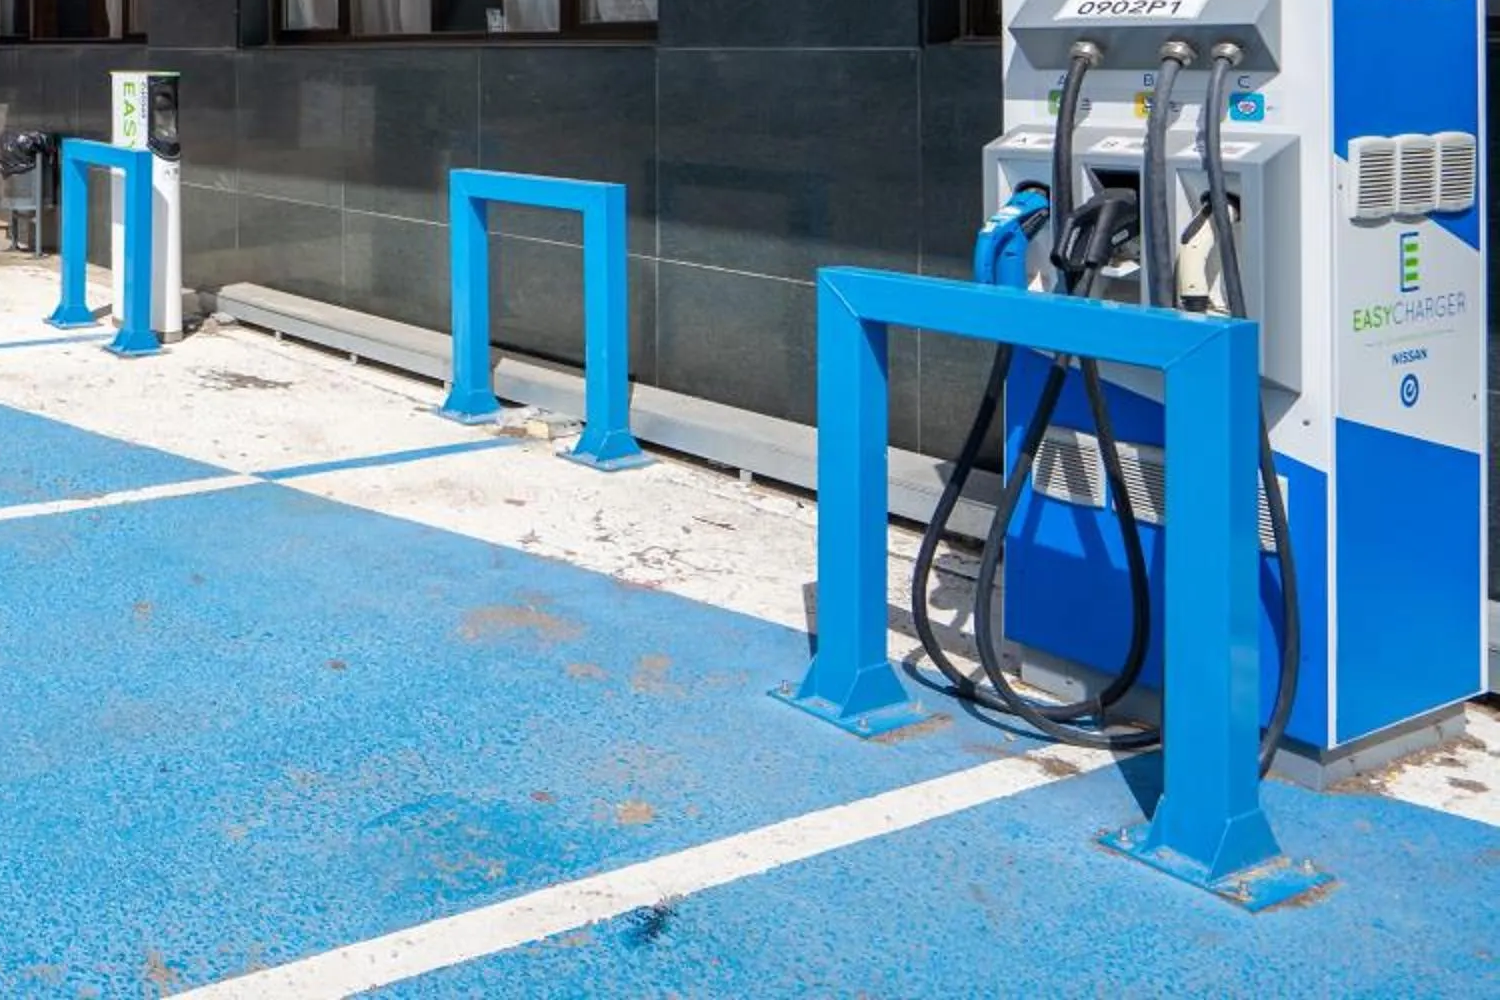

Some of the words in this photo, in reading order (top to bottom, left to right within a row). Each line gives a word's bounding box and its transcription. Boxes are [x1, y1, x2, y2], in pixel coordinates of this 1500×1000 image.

[1077, 0, 1183, 15] 0902P1
[1352, 291, 1467, 332] EASYCHARGER
[1391, 347, 1428, 365] NISSAN
